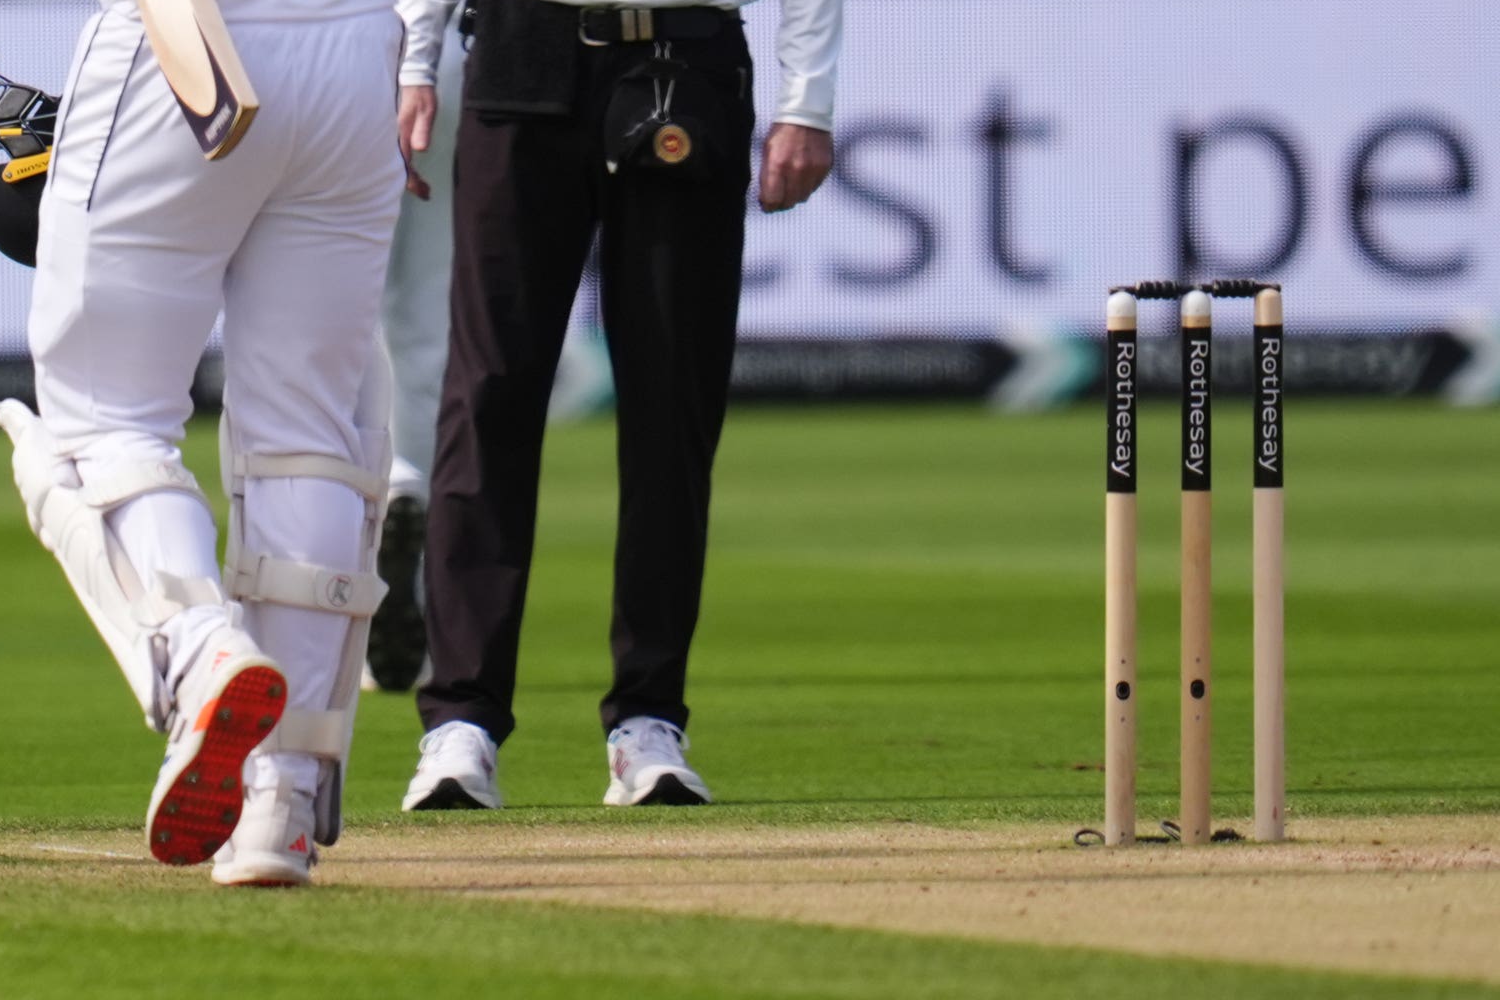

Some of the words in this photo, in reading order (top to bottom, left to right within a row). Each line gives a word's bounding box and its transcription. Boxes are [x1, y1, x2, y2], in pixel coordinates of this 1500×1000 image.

[1170, 105, 1478, 332] pe
[1111, 341, 1135, 478] Rothesay
[1185, 340, 1209, 476] Rothesay
[1258, 337, 1281, 473] Rothesay
